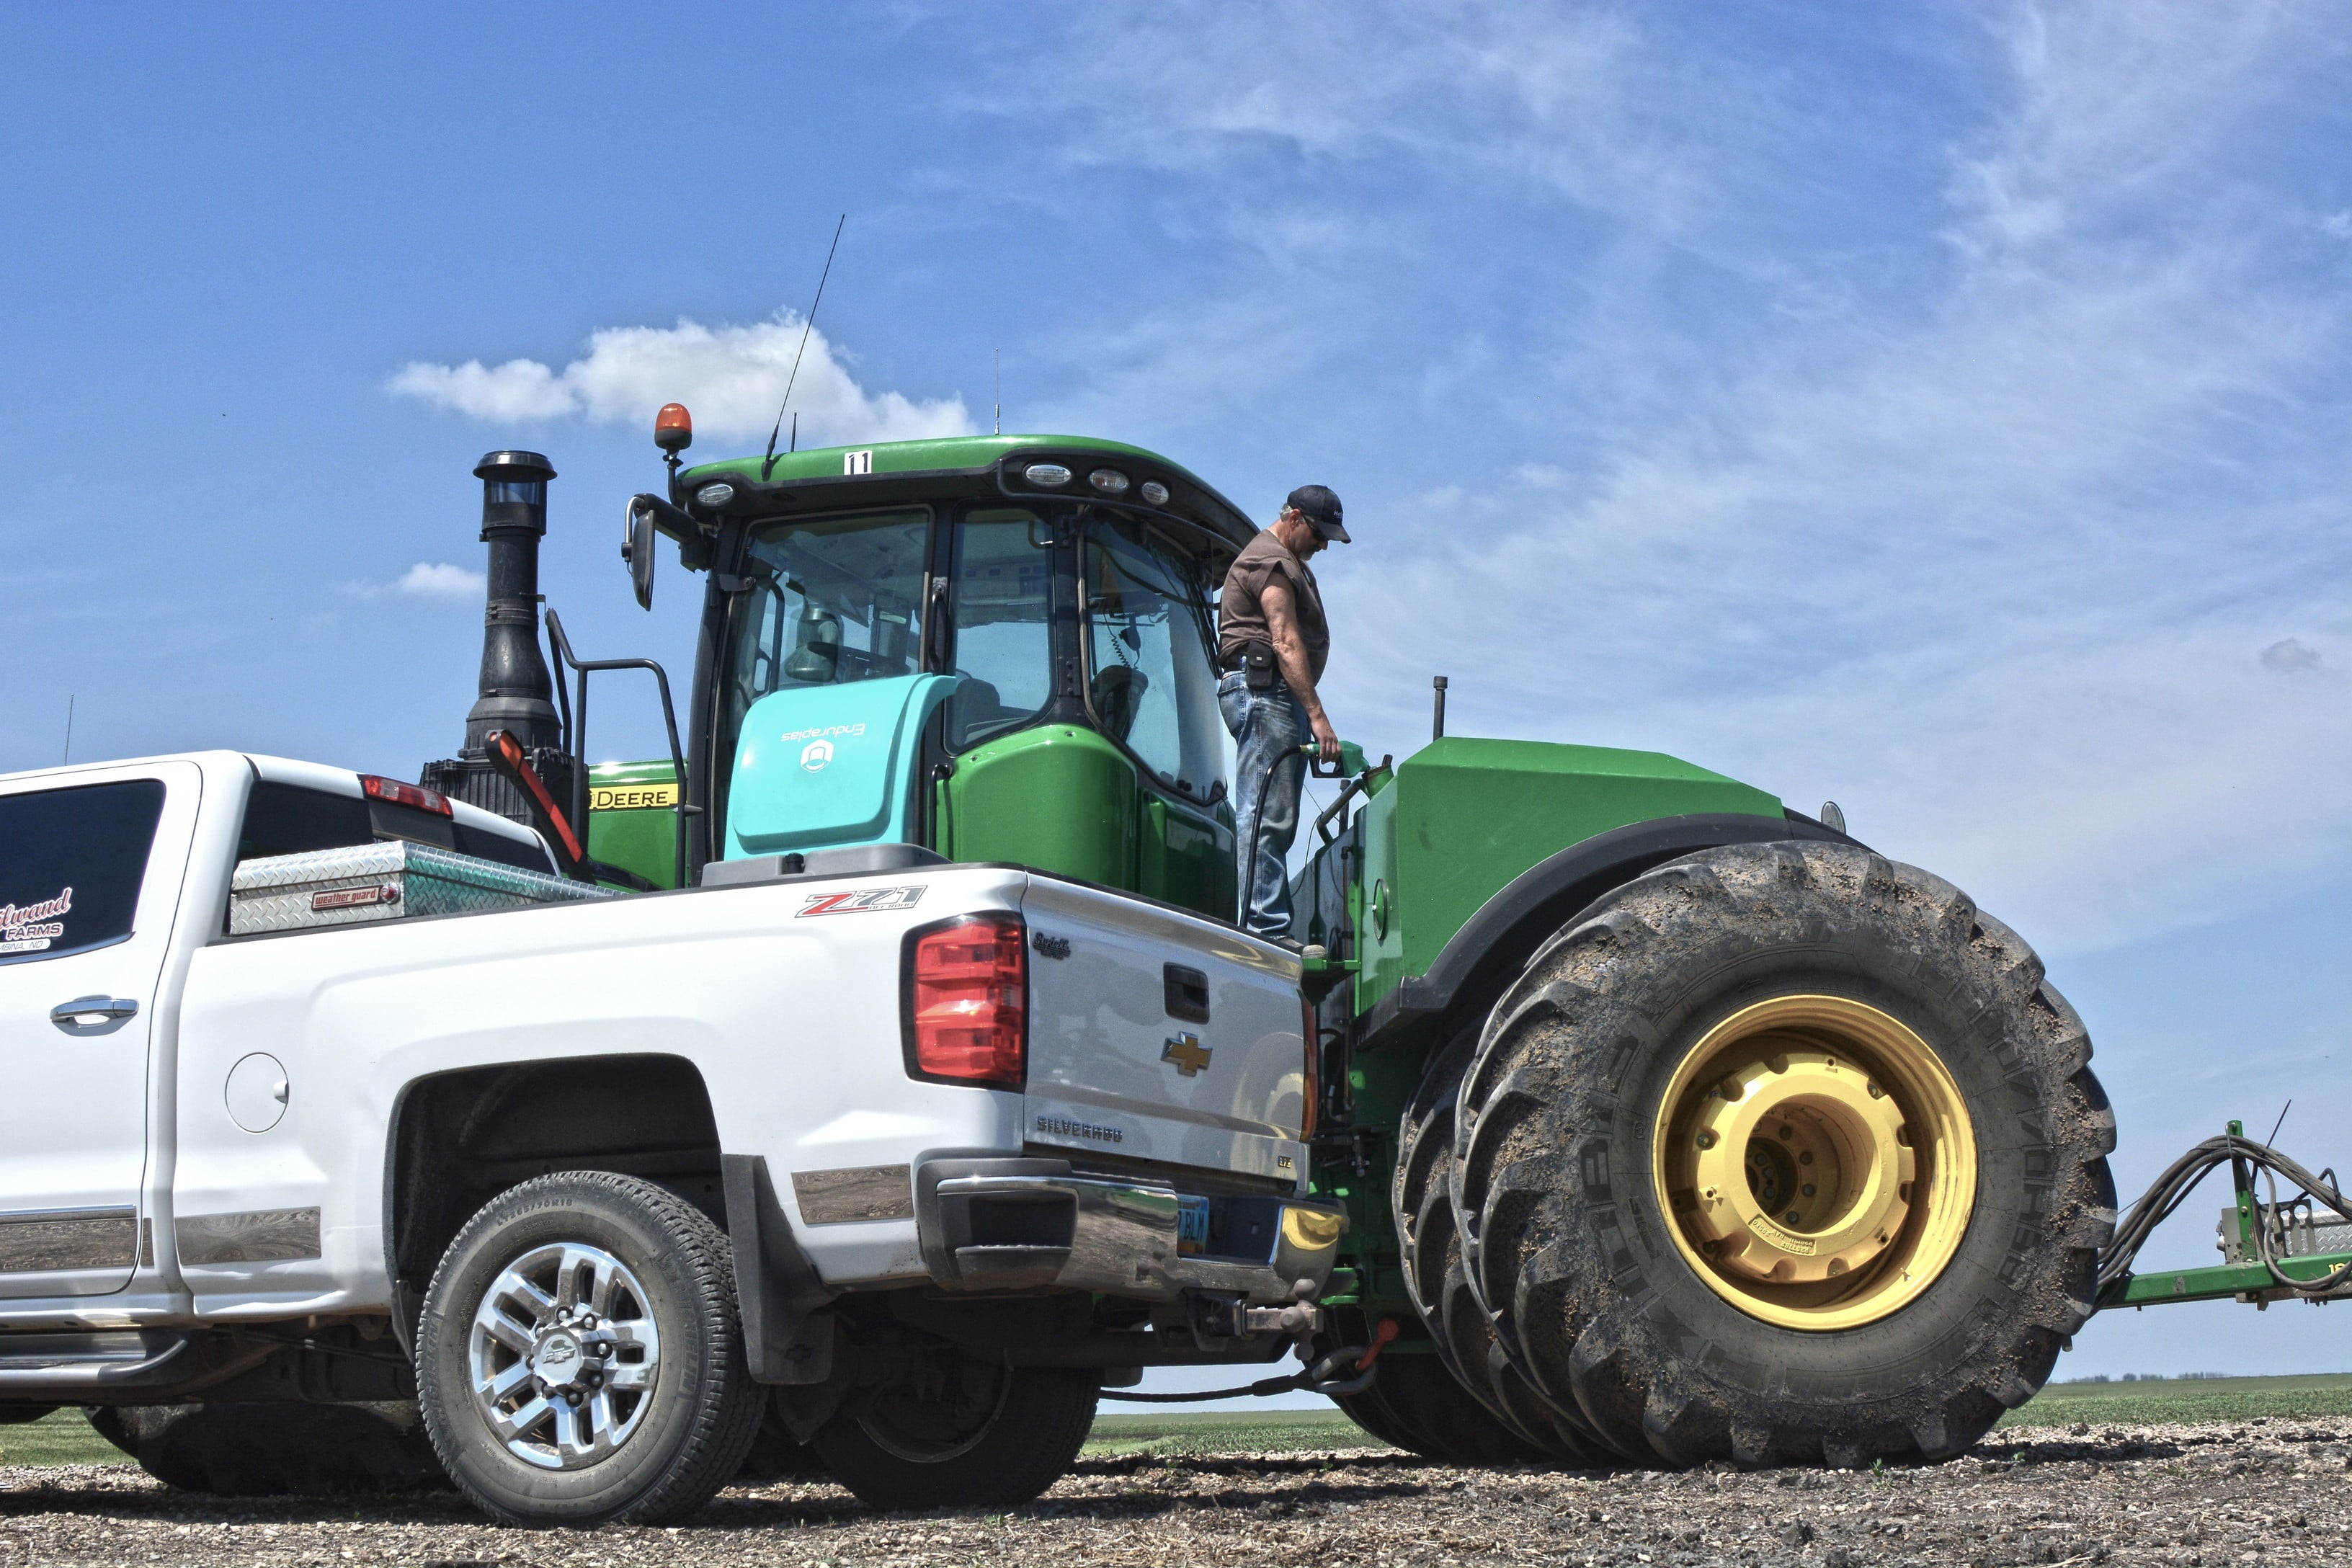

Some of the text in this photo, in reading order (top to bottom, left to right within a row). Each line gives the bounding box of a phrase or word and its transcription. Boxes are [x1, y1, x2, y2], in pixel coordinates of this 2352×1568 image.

[848, 453, 868, 475] 11
[780, 723, 865, 742] Enduraplas
[597, 791, 669, 807] DEERE
[315, 888, 376, 905] weather guard
[795, 886, 928, 918] Z71
[6, 923, 63, 940] FARMS
[29, 940, 43, 949] ND
[1037, 1115, 1123, 1143] SILVERADO
